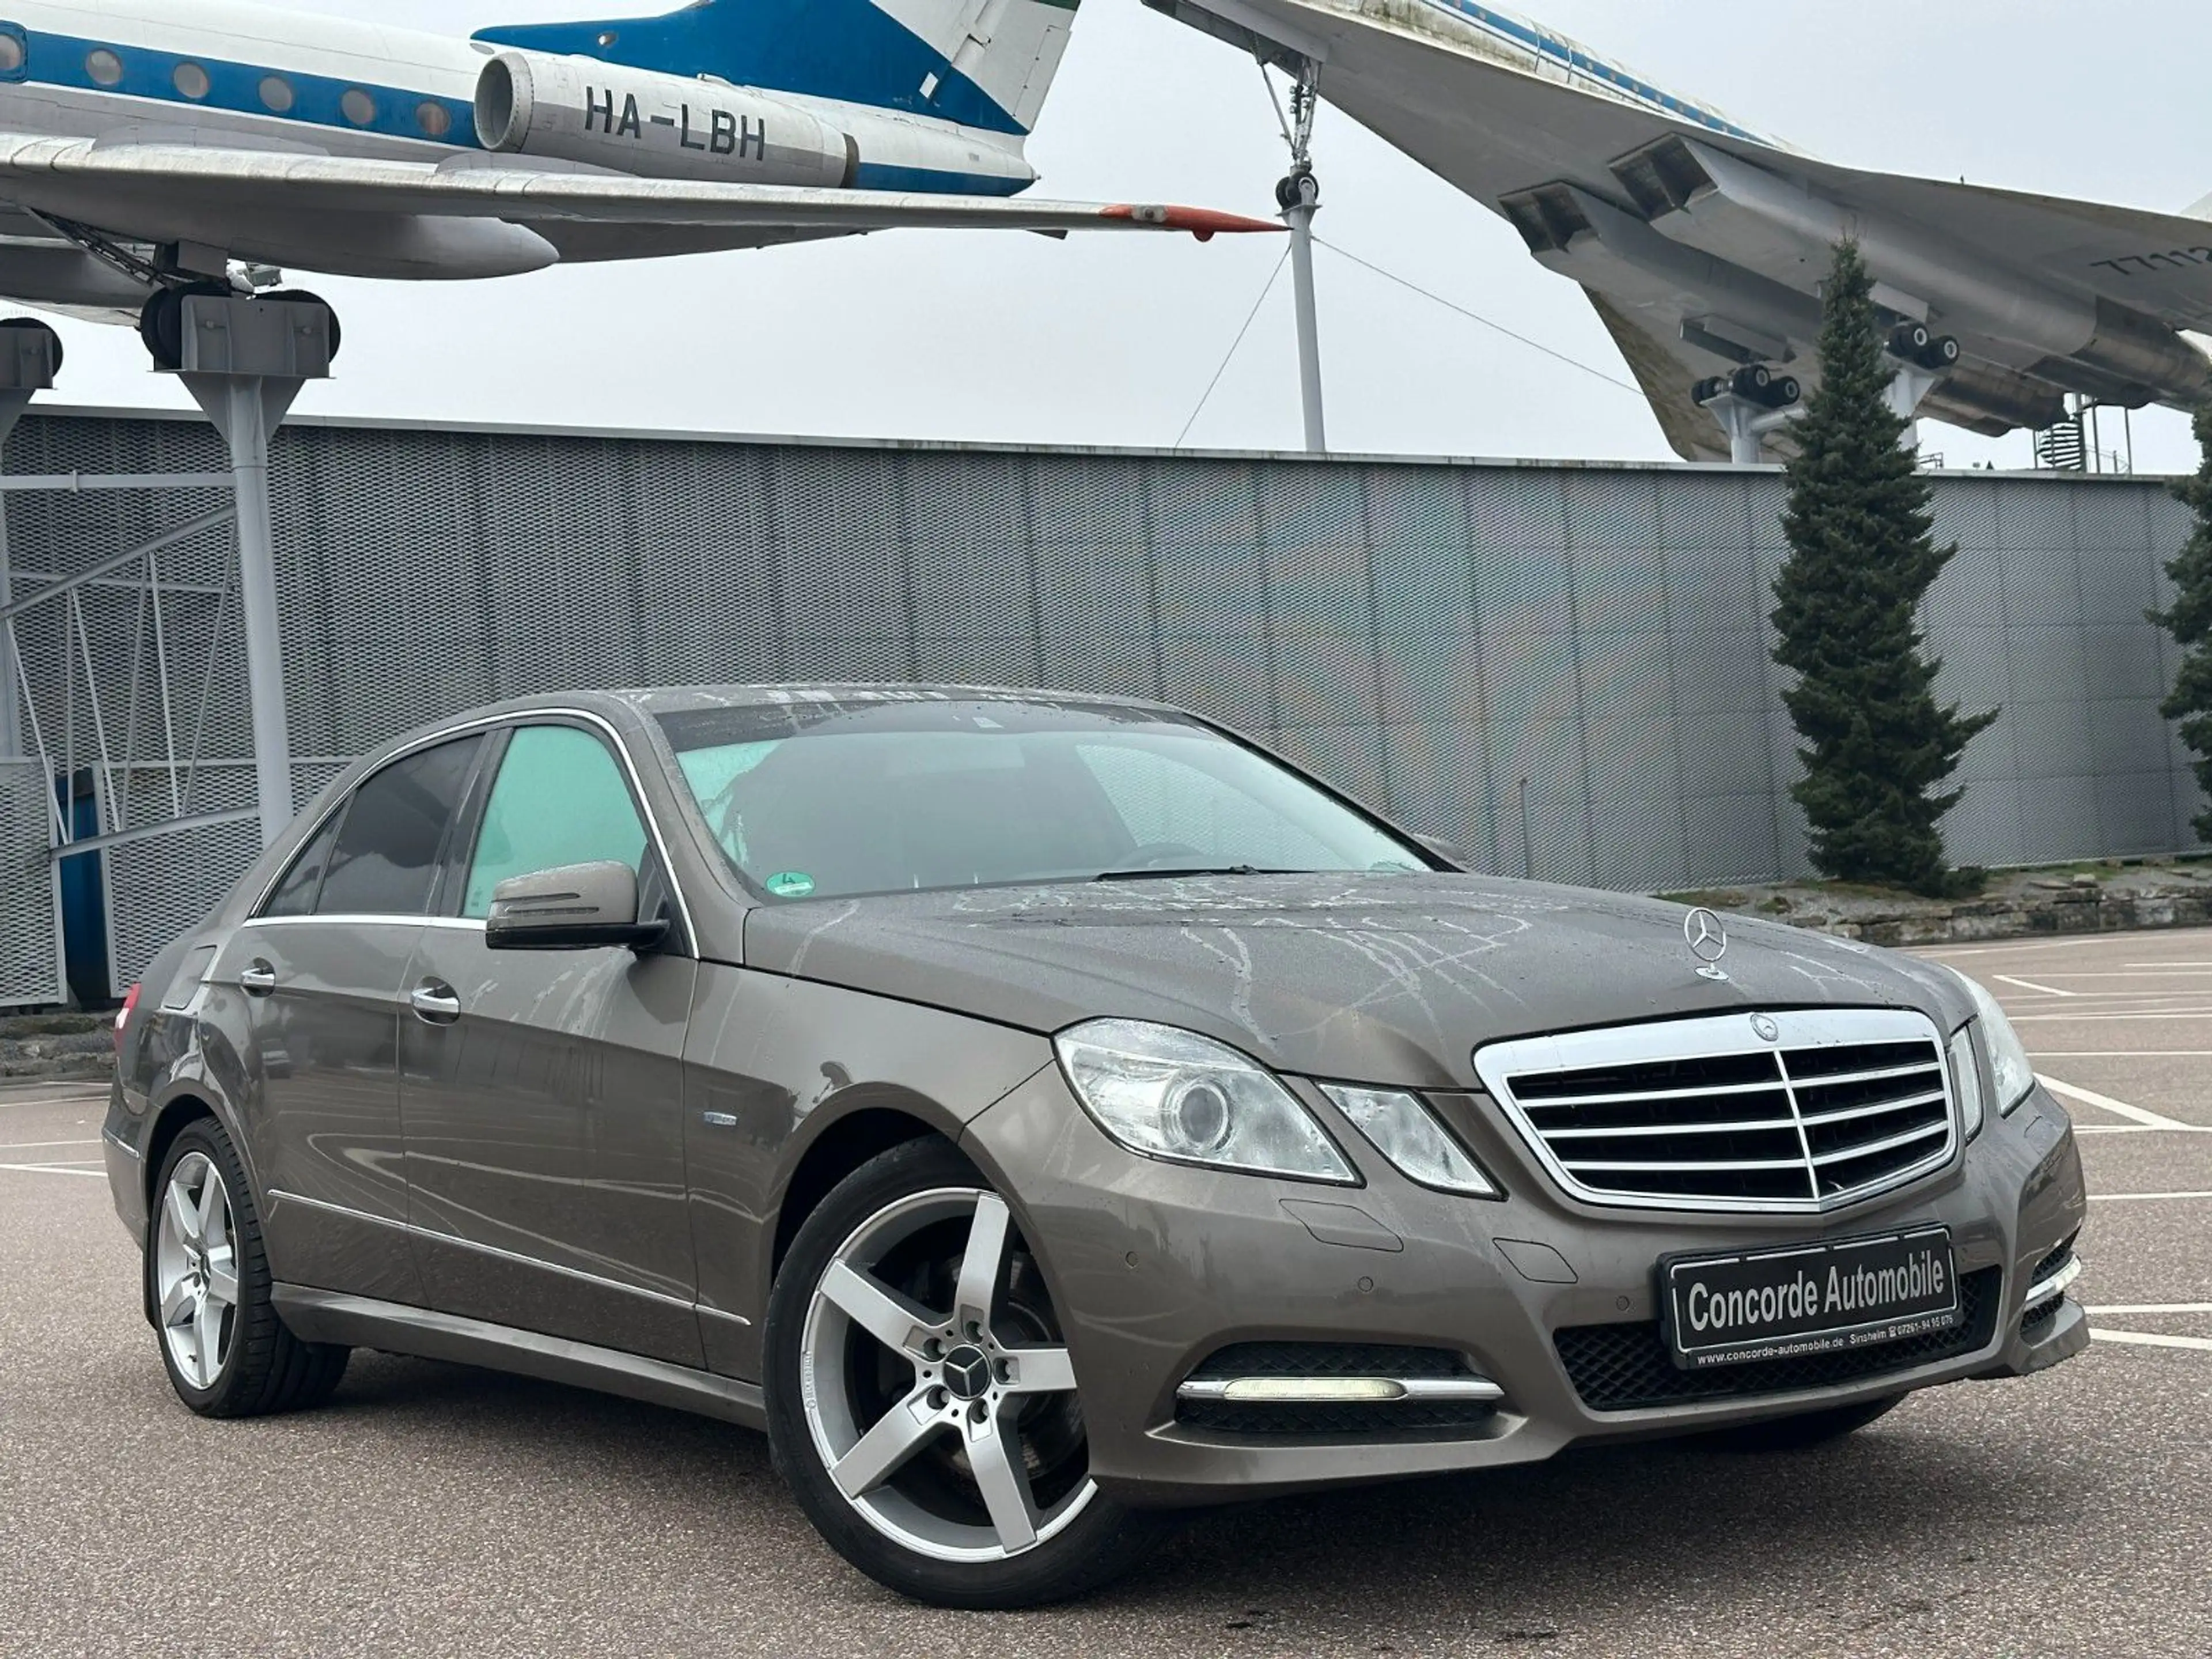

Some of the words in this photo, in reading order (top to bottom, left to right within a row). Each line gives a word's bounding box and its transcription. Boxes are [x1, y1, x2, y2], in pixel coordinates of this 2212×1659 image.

[585, 86, 764, 161] HA-LBH
[1689, 1270, 1818, 1331] Concorde
[1824, 1249, 1944, 1313] Automobile
[1697, 1337, 1844, 1365] www.concorde-automobile.de
[1849, 1330, 1887, 1344] Sinsheim
